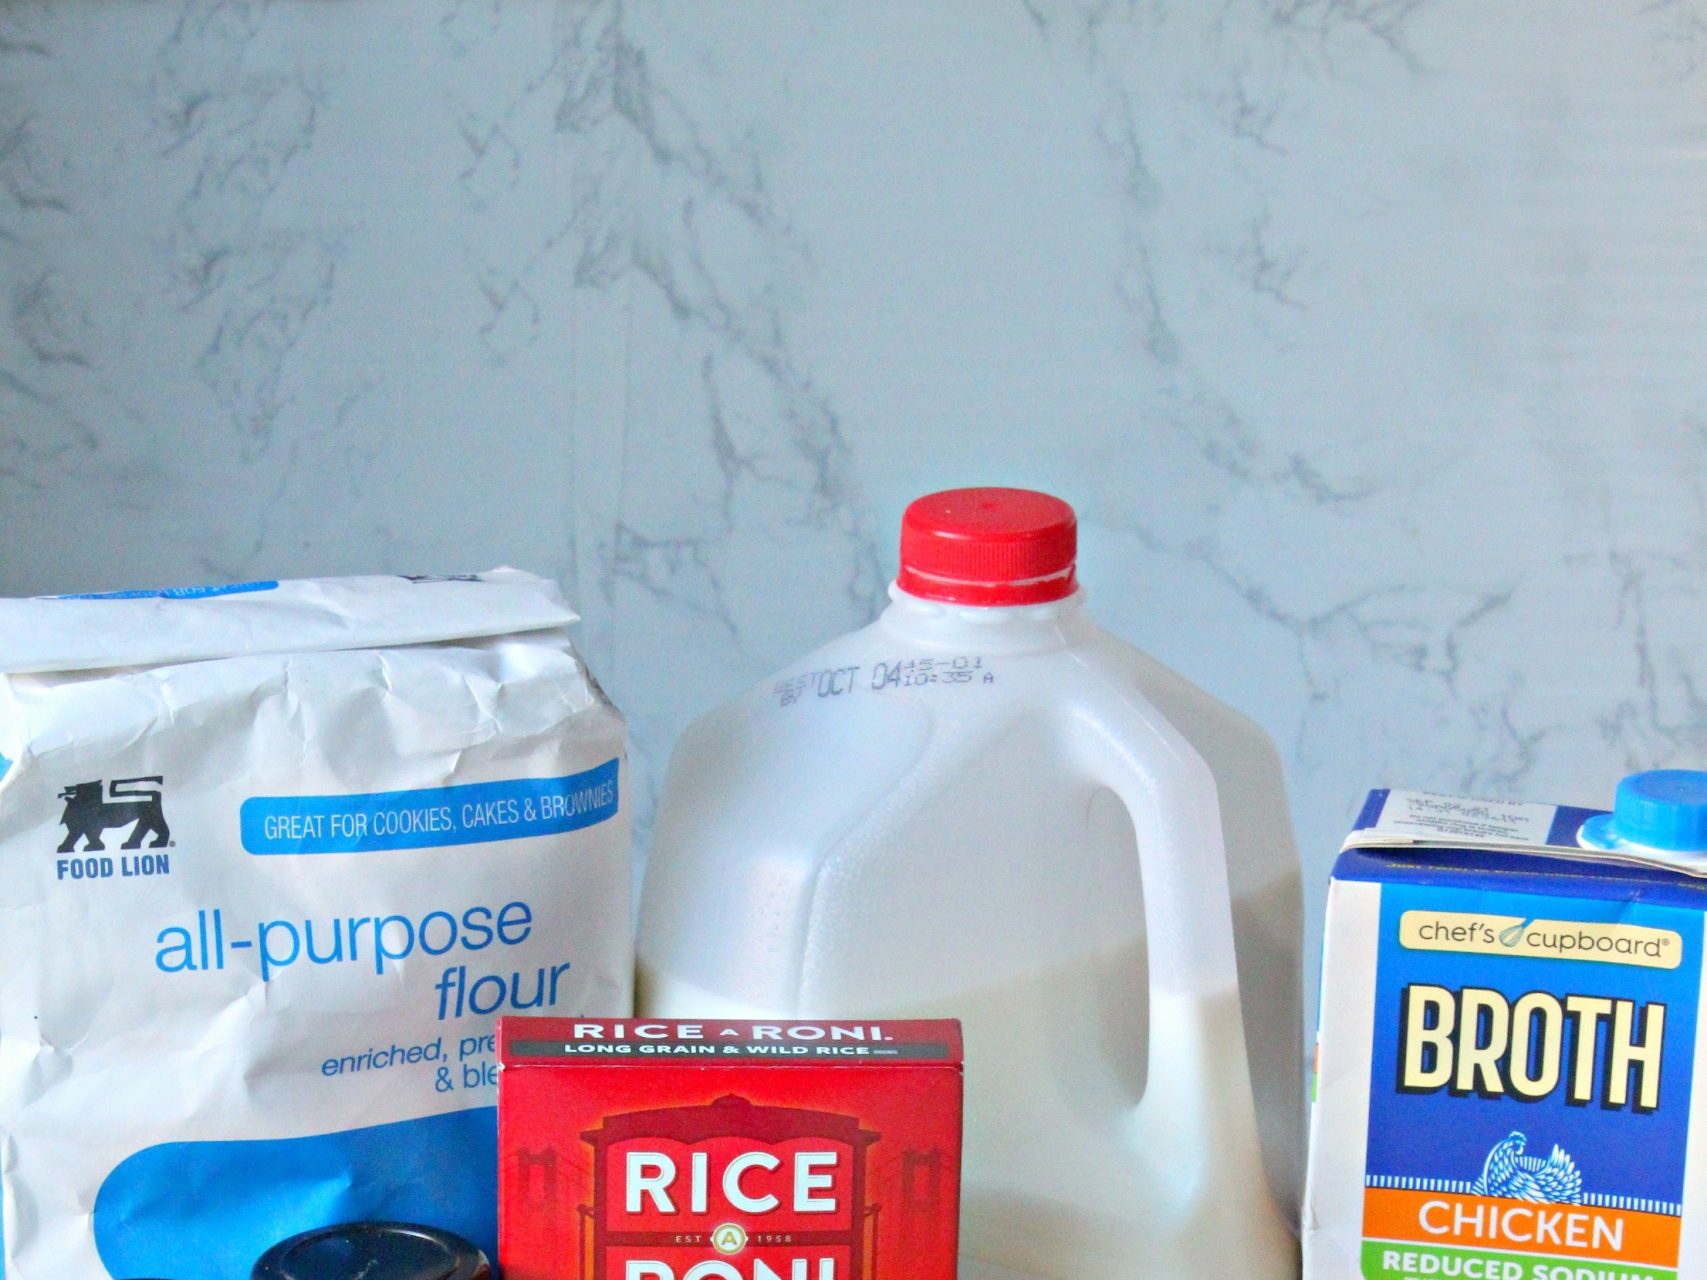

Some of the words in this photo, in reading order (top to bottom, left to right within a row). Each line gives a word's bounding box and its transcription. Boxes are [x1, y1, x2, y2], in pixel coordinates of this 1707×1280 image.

[818, 666, 859, 697] OCT
[872, 662, 903, 690] 04
[983, 673, 993, 684] A
[265, 814, 323, 841] GREAT
[331, 812, 368, 837] FOR
[373, 808, 457, 837] COOKIES,
[462, 800, 518, 827] CAKES
[524, 798, 537, 821] &
[541, 786, 614, 818] BROWNIES
[57, 858, 113, 880] FOOD
[122, 854, 169, 876] LION
[155, 901, 532, 982] all-purpose
[1419, 920, 1495, 944] chef's
[436, 962, 570, 1020] flour
[574, 1024, 704, 1039] RICE
[1399, 982, 1667, 1113] BROTH
[322, 1037, 448, 1076] enriched,
[565, 1045, 632, 1053] LONG
[640, 1045, 715, 1053] GRAIN
[747, 1046, 809, 1055] WILD
[817, 1047, 869, 1055] RICE
[435, 1067, 453, 1092] &
[626, 1151, 837, 1214] RICE
[676, 1235, 701, 1243] EST
[719, 1230, 738, 1246] A
[757, 1235, 791, 1243] 1958
[1419, 1201, 1624, 1251] CHICKEN
